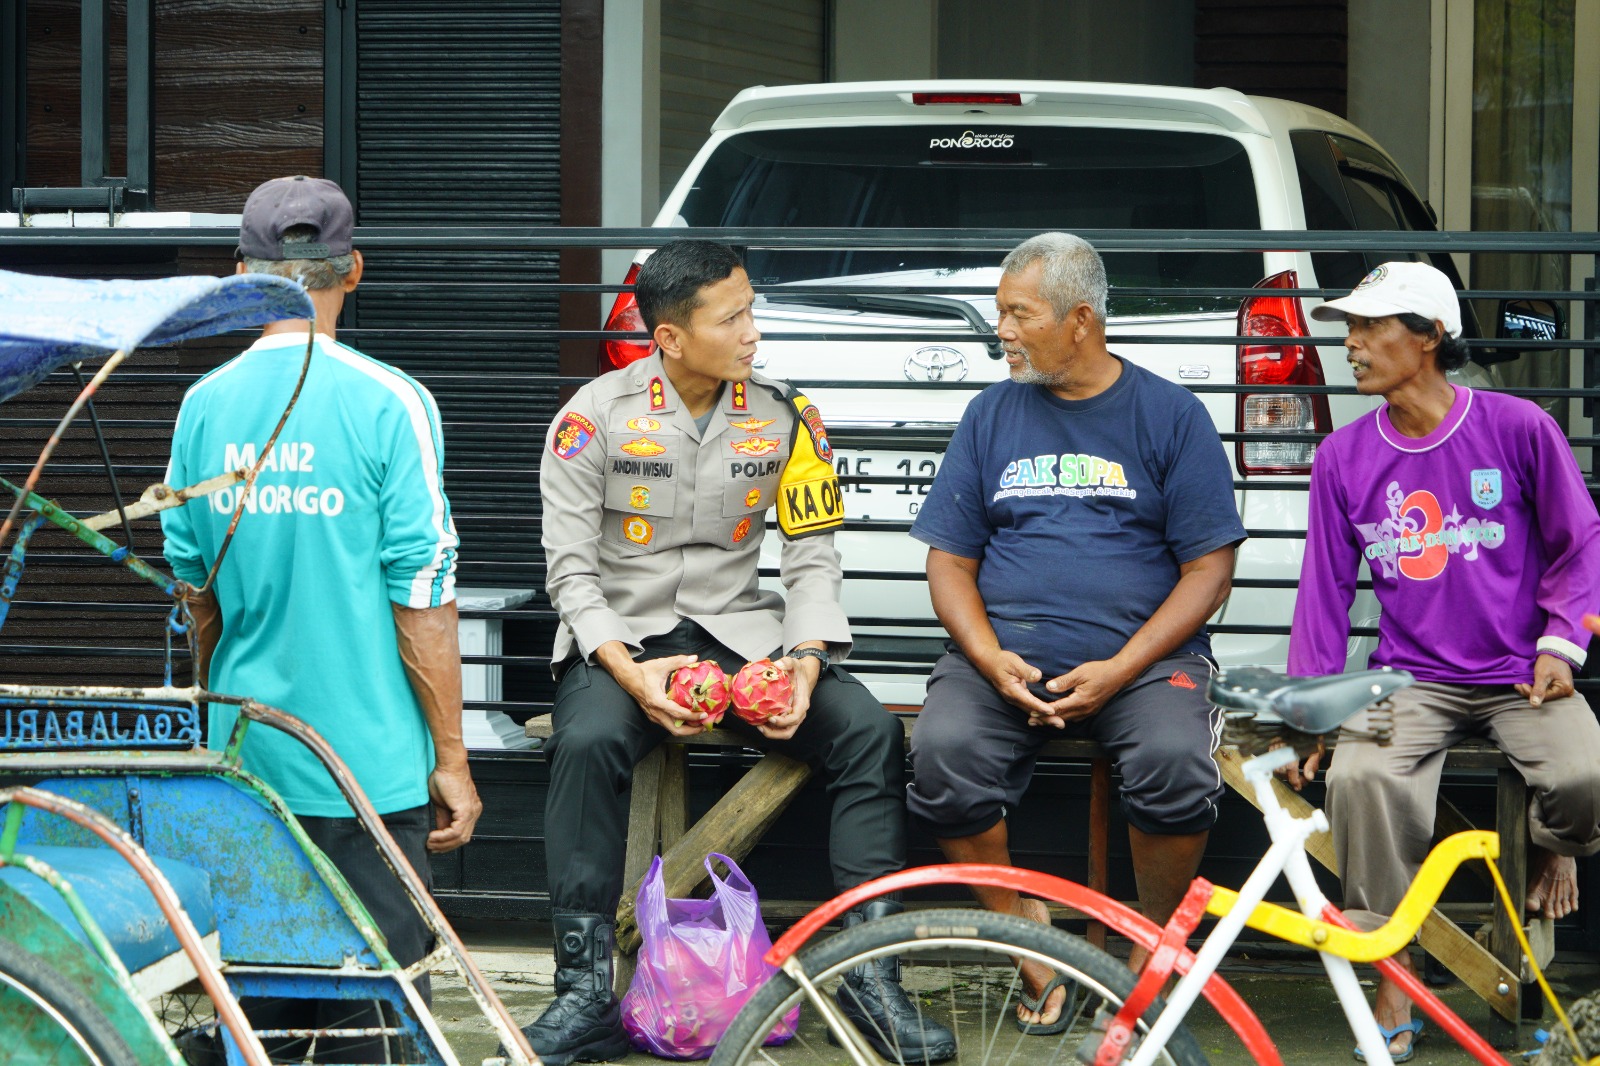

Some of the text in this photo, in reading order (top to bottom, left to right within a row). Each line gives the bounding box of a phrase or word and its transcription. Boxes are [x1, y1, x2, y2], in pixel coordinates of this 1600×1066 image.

[929, 137, 1014, 149] PONOROGO
[567, 412, 595, 433] PROPAM
[612, 460, 673, 478] ANDIN WISNU
[730, 460, 781, 478] POLRI
[836, 456, 872, 493] AE
[1000, 453, 1128, 488] CAK SOPA
[786, 479, 844, 522] KA OP
[1096, 486, 1104, 496] &
